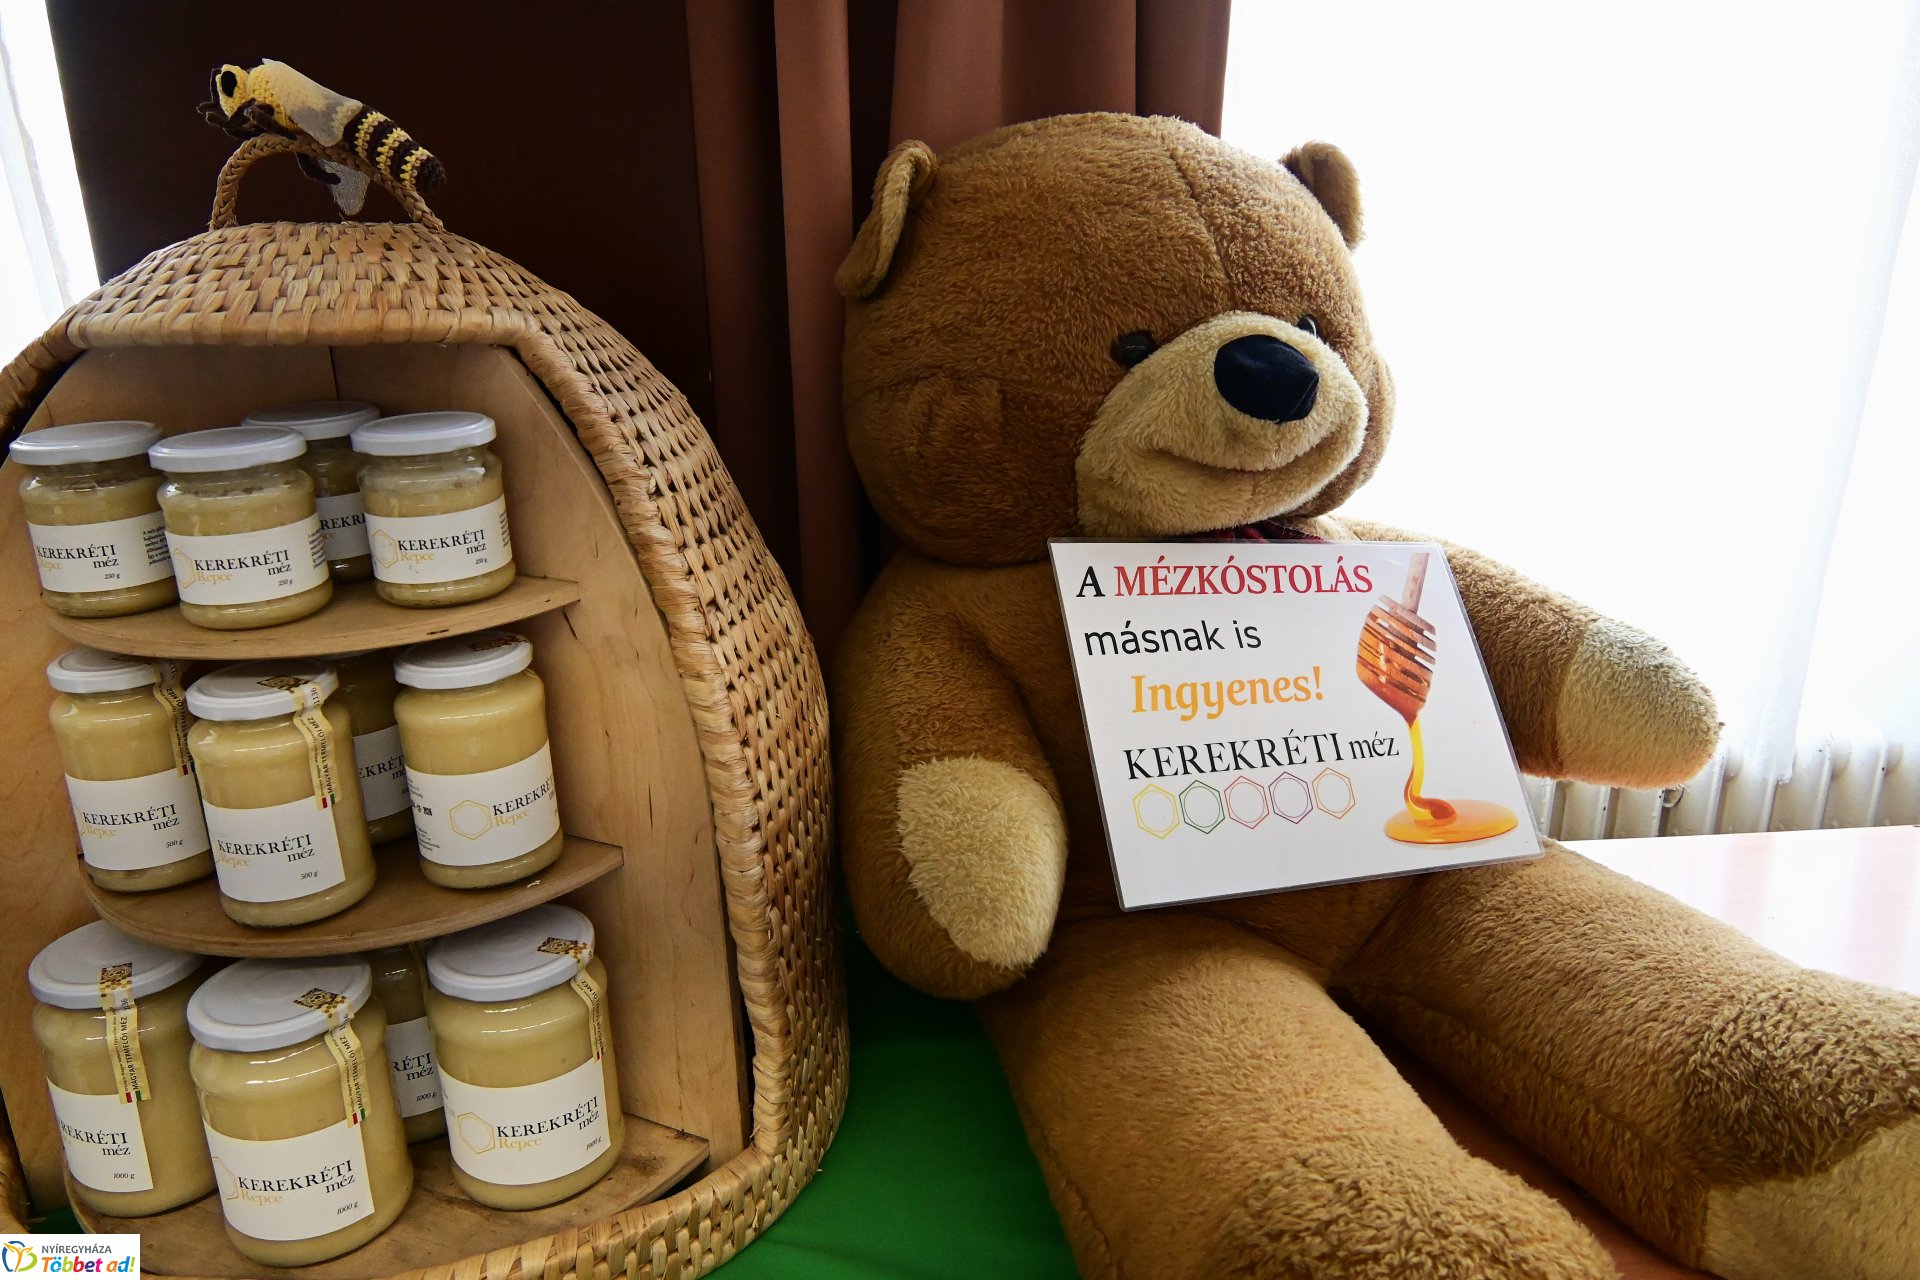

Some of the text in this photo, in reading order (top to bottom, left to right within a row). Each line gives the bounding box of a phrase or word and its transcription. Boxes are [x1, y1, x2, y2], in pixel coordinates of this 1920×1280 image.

[397, 529, 485, 551] KEREKRÉTI
[466, 541, 487, 555] méz
[36, 544, 117, 560] KEREKRÉTI
[194, 549, 290, 571] KEREKRÉTI
[400, 551, 435, 565] Repce
[93, 556, 120, 569] méz
[267, 561, 292, 576] méz
[197, 571, 233, 585] Repce
[278, 579, 289, 587] 250
[1076, 555, 1373, 598] A MÉZKÓSTOLÁS
[1084, 619, 1262, 656] másnak is
[1130, 665, 1325, 723] Ingyenes!
[1123, 729, 1400, 780] KEREKRÉTI méz
[82, 804, 177, 826] KEREKRÉTI
[153, 814, 180, 831] méz
[494, 808, 530, 827] Repce
[165, 840, 178, 848] 500
[218, 833, 313, 856] KEREKRÉTI
[287, 847, 315, 863] méz
[300, 872, 313, 880] 500
[128, 1063, 139, 1090] MAGYAR
[406, 1066, 434, 1081] méz
[416, 1092, 431, 1102] 1000
[497, 1095, 598, 1138] KEREKRÉTI
[579, 1110, 600, 1131] méz
[102, 1144, 131, 1156] méz
[499, 1136, 543, 1152] Repce
[586, 1137, 598, 1151] 1000
[238, 1159, 353, 1192] KEREKRÉTI
[325, 1173, 356, 1194] méz
[241, 1189, 283, 1206] Repce
[336, 1203, 353, 1215] 1000
